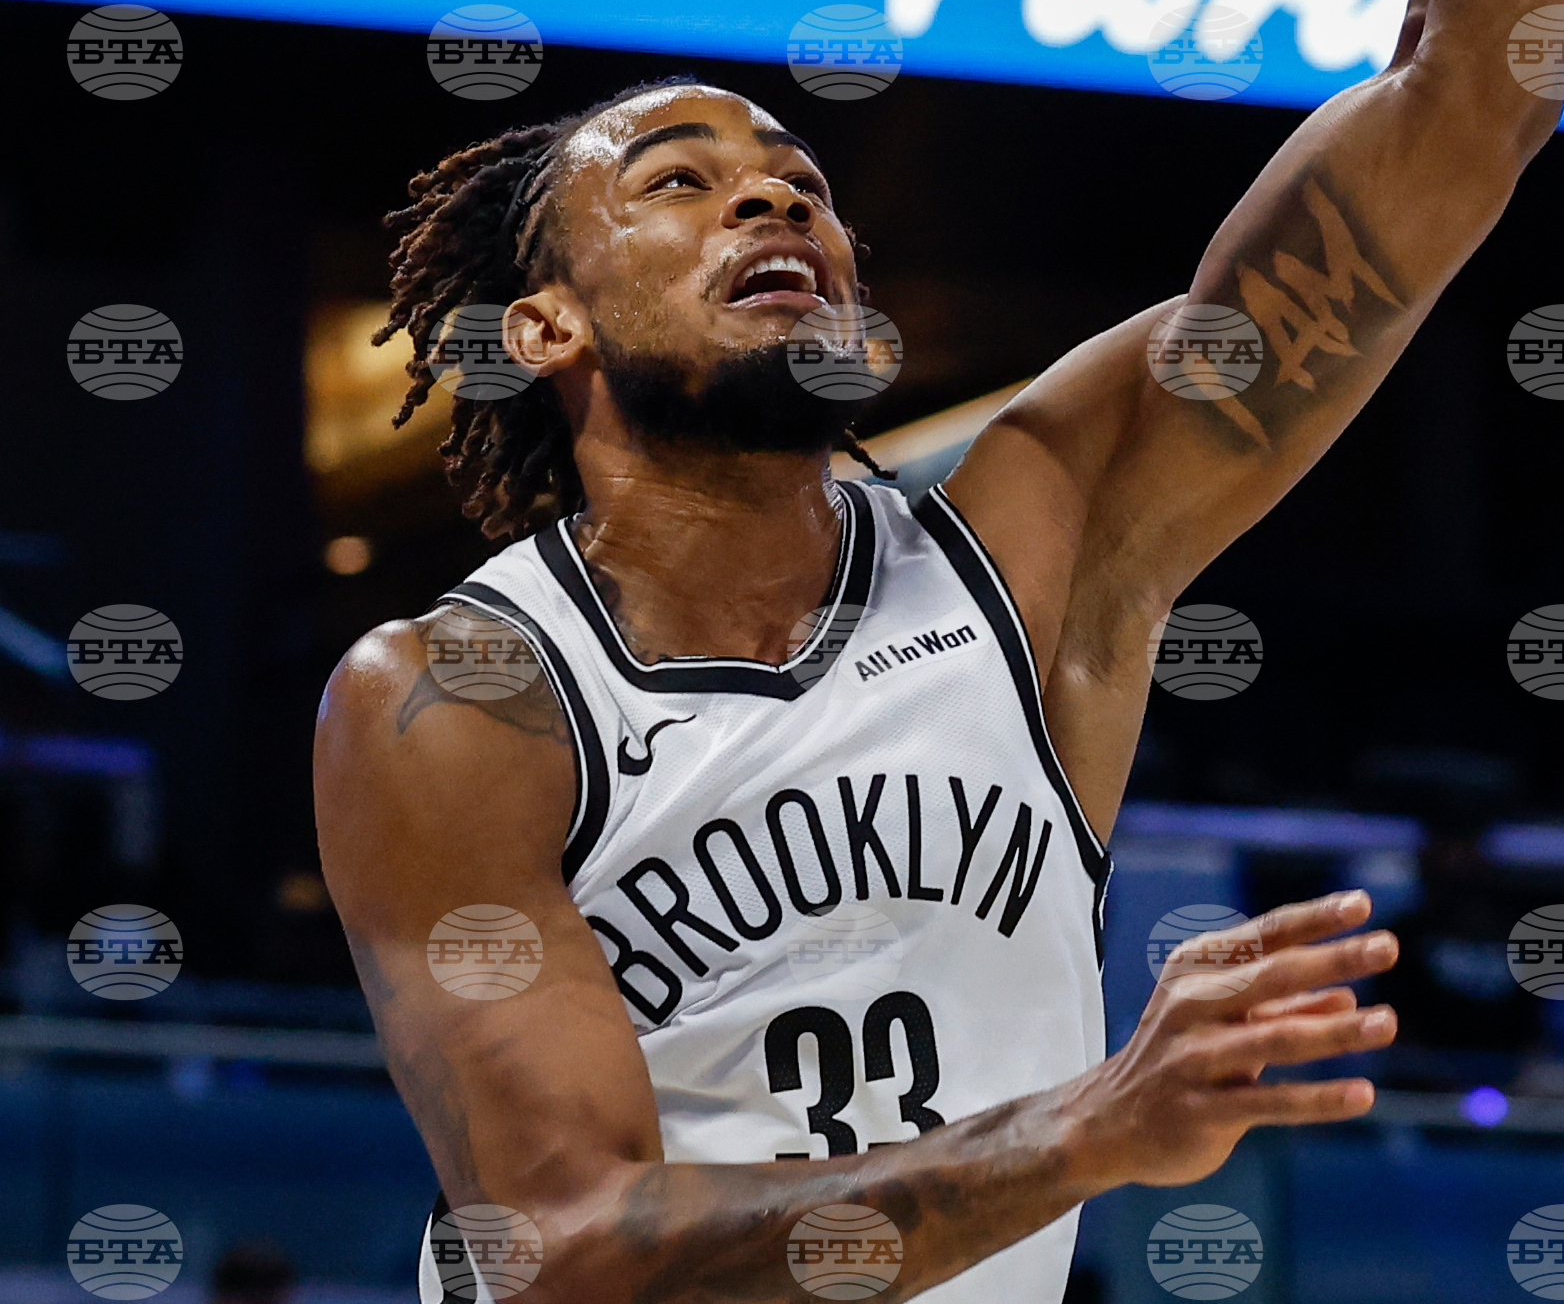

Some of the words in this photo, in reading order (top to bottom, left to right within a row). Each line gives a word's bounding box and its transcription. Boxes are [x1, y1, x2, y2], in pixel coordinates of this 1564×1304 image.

[854, 650, 893, 682] All
[887, 644, 922, 664] In
[912, 624, 978, 655] Won
[585, 773, 1053, 1026] BROOKLYN
